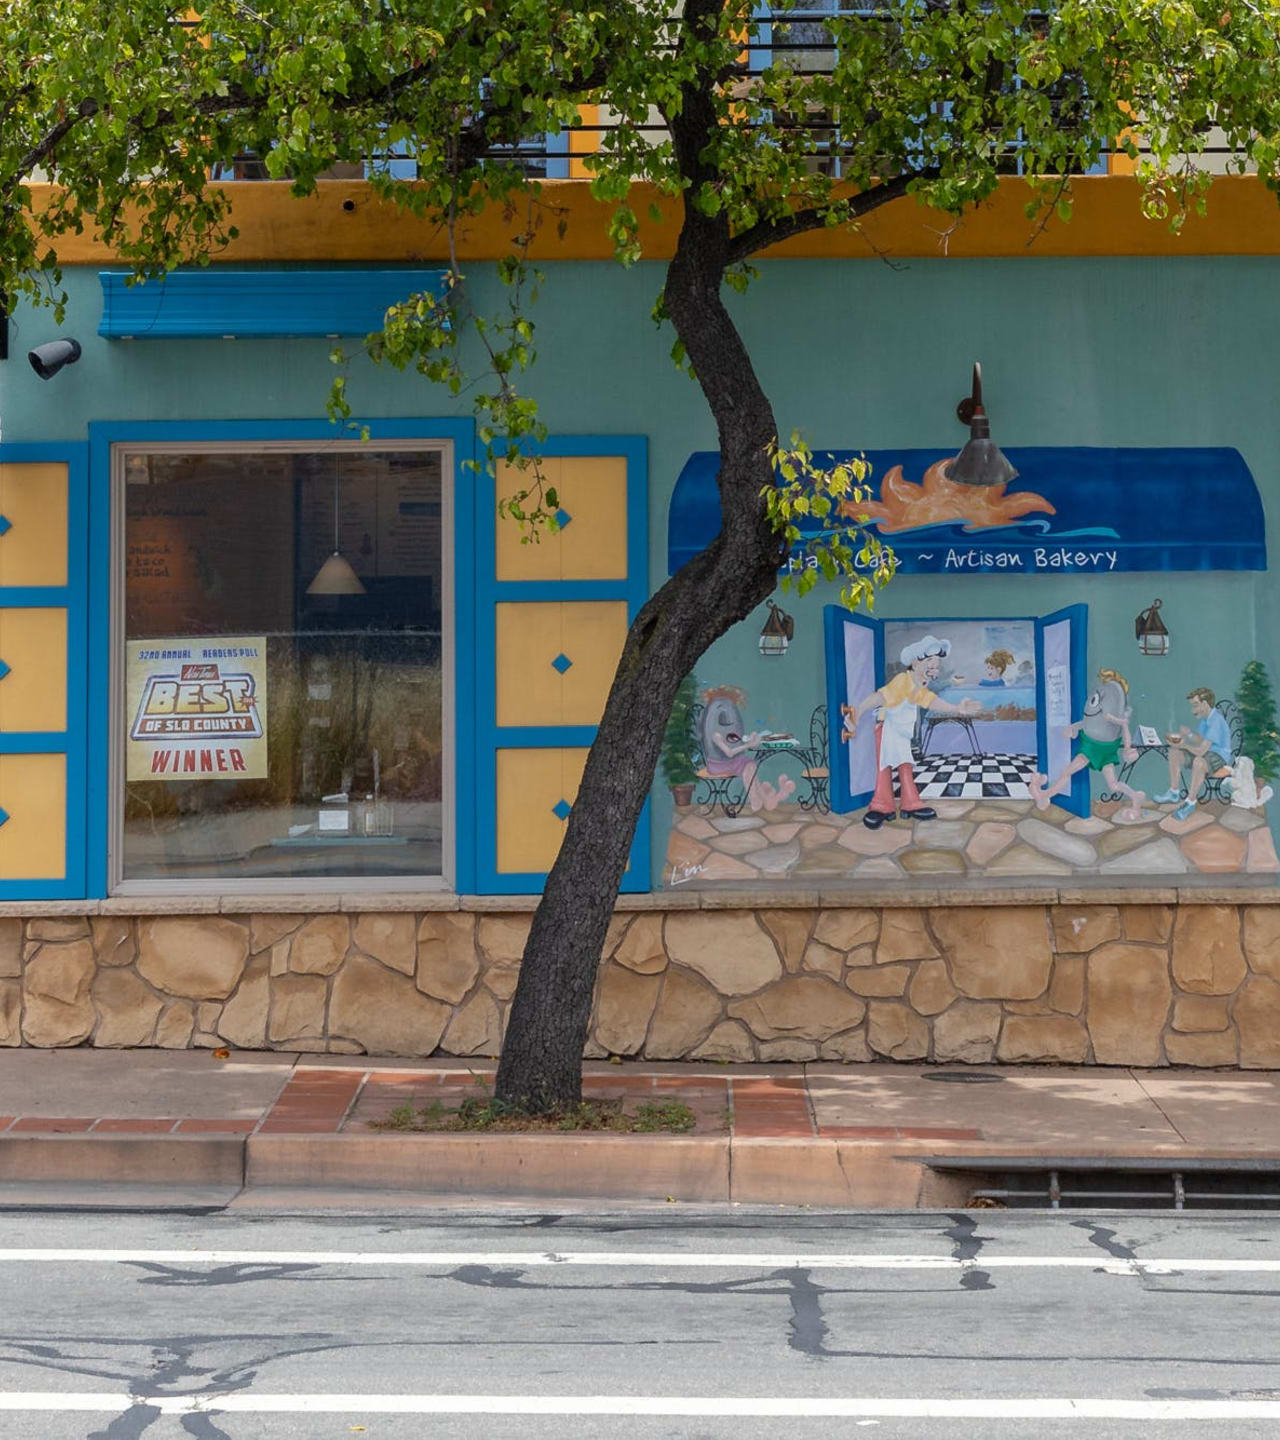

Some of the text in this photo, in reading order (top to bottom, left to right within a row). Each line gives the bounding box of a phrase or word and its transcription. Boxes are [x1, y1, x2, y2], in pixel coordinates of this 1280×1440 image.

[945, 548, 1024, 568] Artisan
[1033, 548, 1118, 570] Bakery
[138, 649, 160, 660] 32ND
[161, 649, 192, 659] ANNUAL
[239, 647, 259, 657] POLL
[144, 679, 250, 715] BEST
[145, 718, 248, 732] OF SLO COUNTY
[151, 748, 247, 773] WINNER
